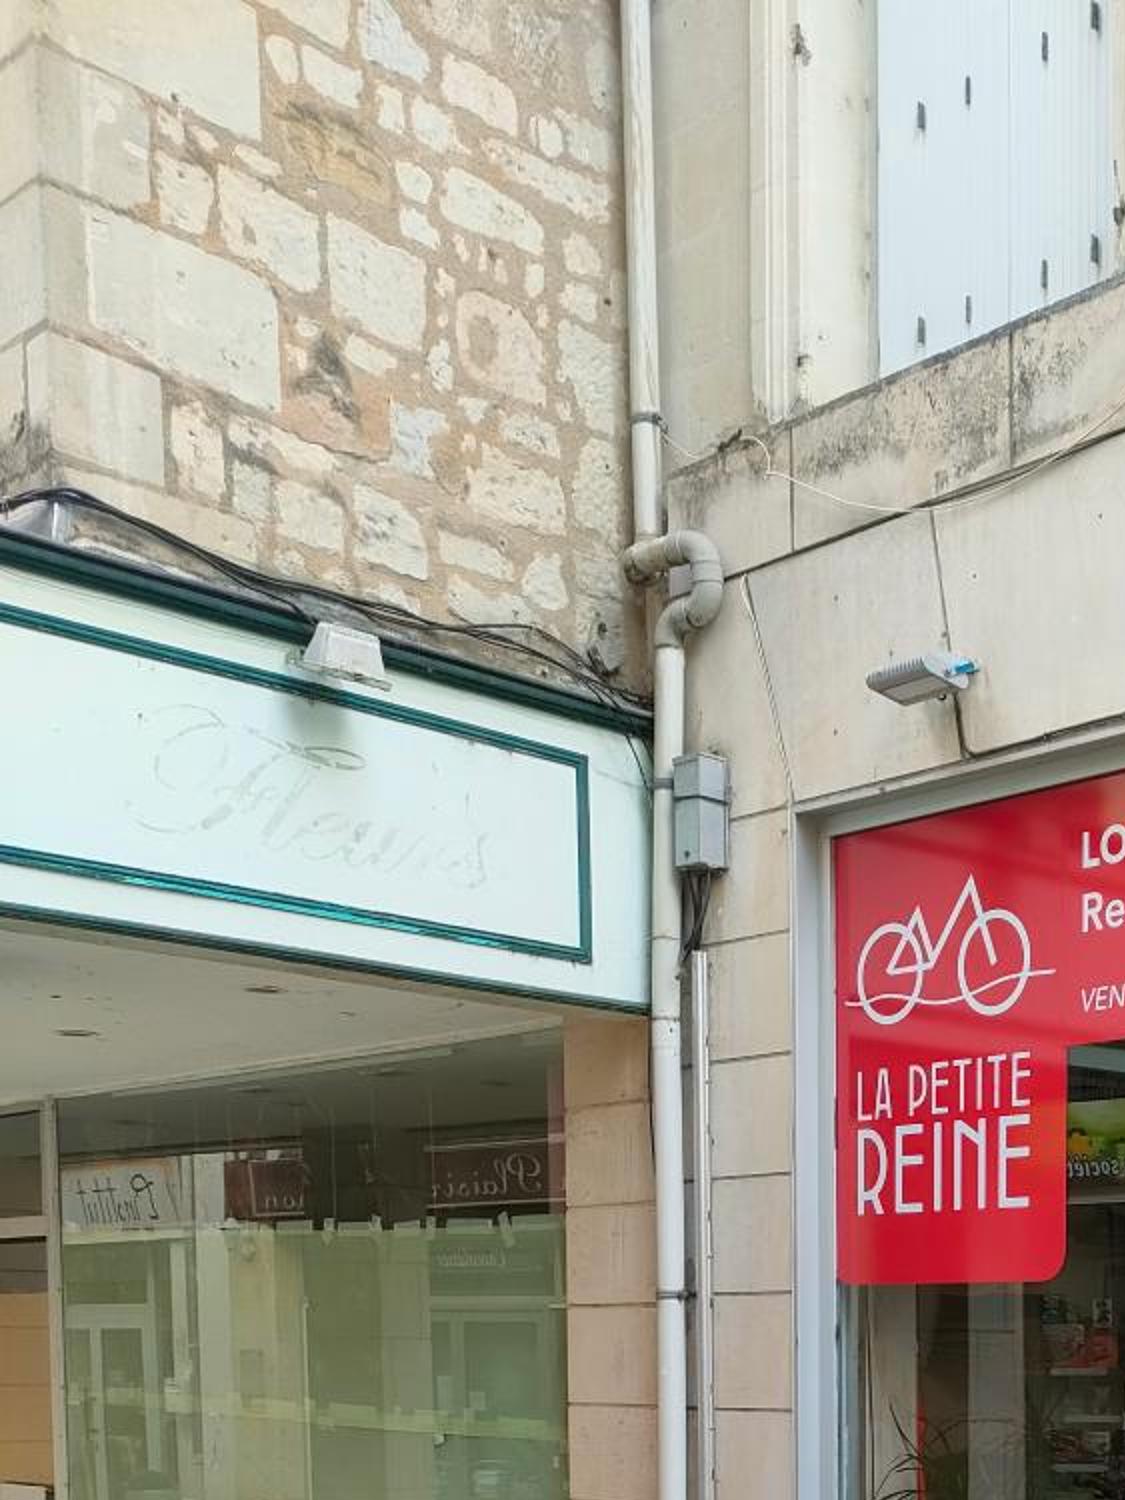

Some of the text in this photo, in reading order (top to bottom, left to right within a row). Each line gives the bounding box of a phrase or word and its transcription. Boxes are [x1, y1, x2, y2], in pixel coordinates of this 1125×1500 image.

[857, 1051, 1031, 1121] LA PETITE
[857, 1113, 1031, 1217] REINE
